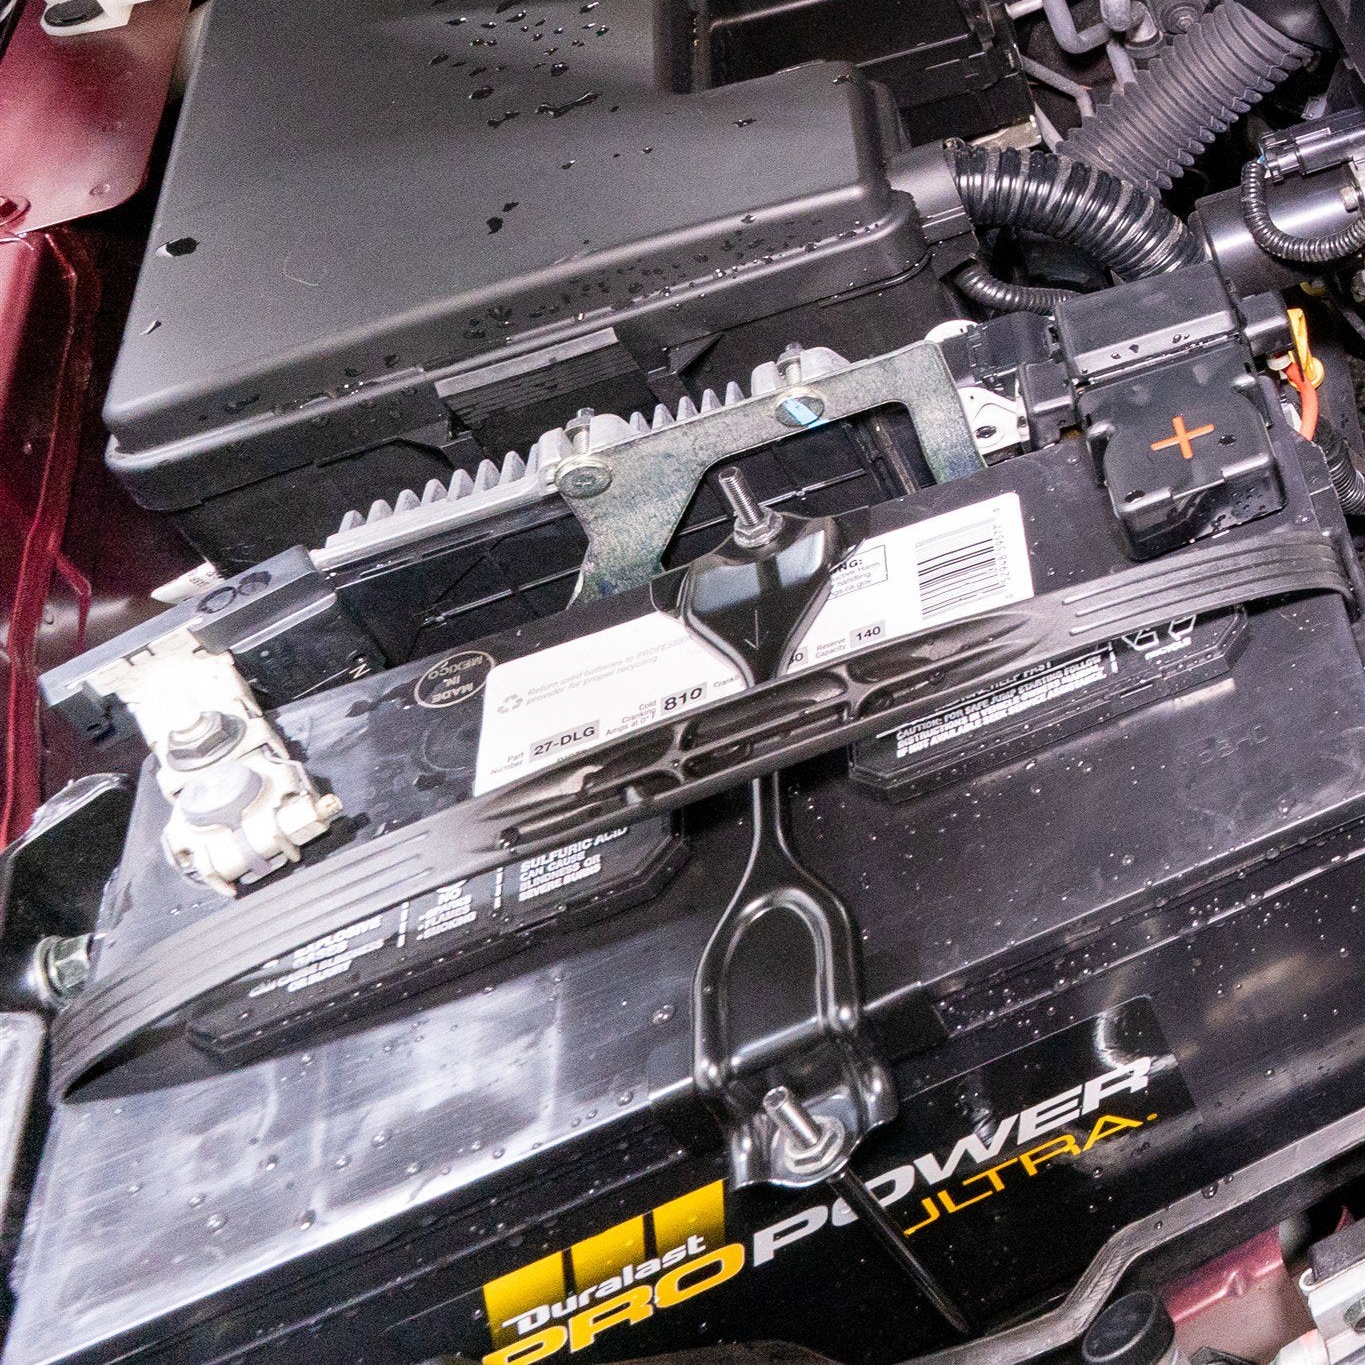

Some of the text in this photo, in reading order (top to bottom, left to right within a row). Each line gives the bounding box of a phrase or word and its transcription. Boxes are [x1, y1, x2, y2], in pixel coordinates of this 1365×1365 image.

[855, 625, 881, 641] 140
[427, 654, 484, 679] MEXICO
[527, 680, 557, 696] Return
[560, 671, 581, 684] used
[584, 658, 624, 677] batteries
[625, 654, 637, 663] to
[429, 682, 474, 703] MADE
[526, 684, 566, 705] provider
[569, 679, 582, 689] for
[582, 668, 615, 685] proper
[663, 686, 702, 712] 810
[621, 705, 656, 723] Cranking
[943, 707, 964, 723] FOR
[962, 697, 989, 715] SAFE
[534, 725, 595, 756] 27-DLG
[605, 722, 629, 736] Amps
[490, 758, 522, 775] Number
[507, 752, 523, 762] Part
[518, 837, 595, 873] SULFURIC
[546, 850, 587, 871] CAUSE
[481, 1057, 1155, 1365] PRO POWER
[501, 1234, 707, 1335] Duralast
